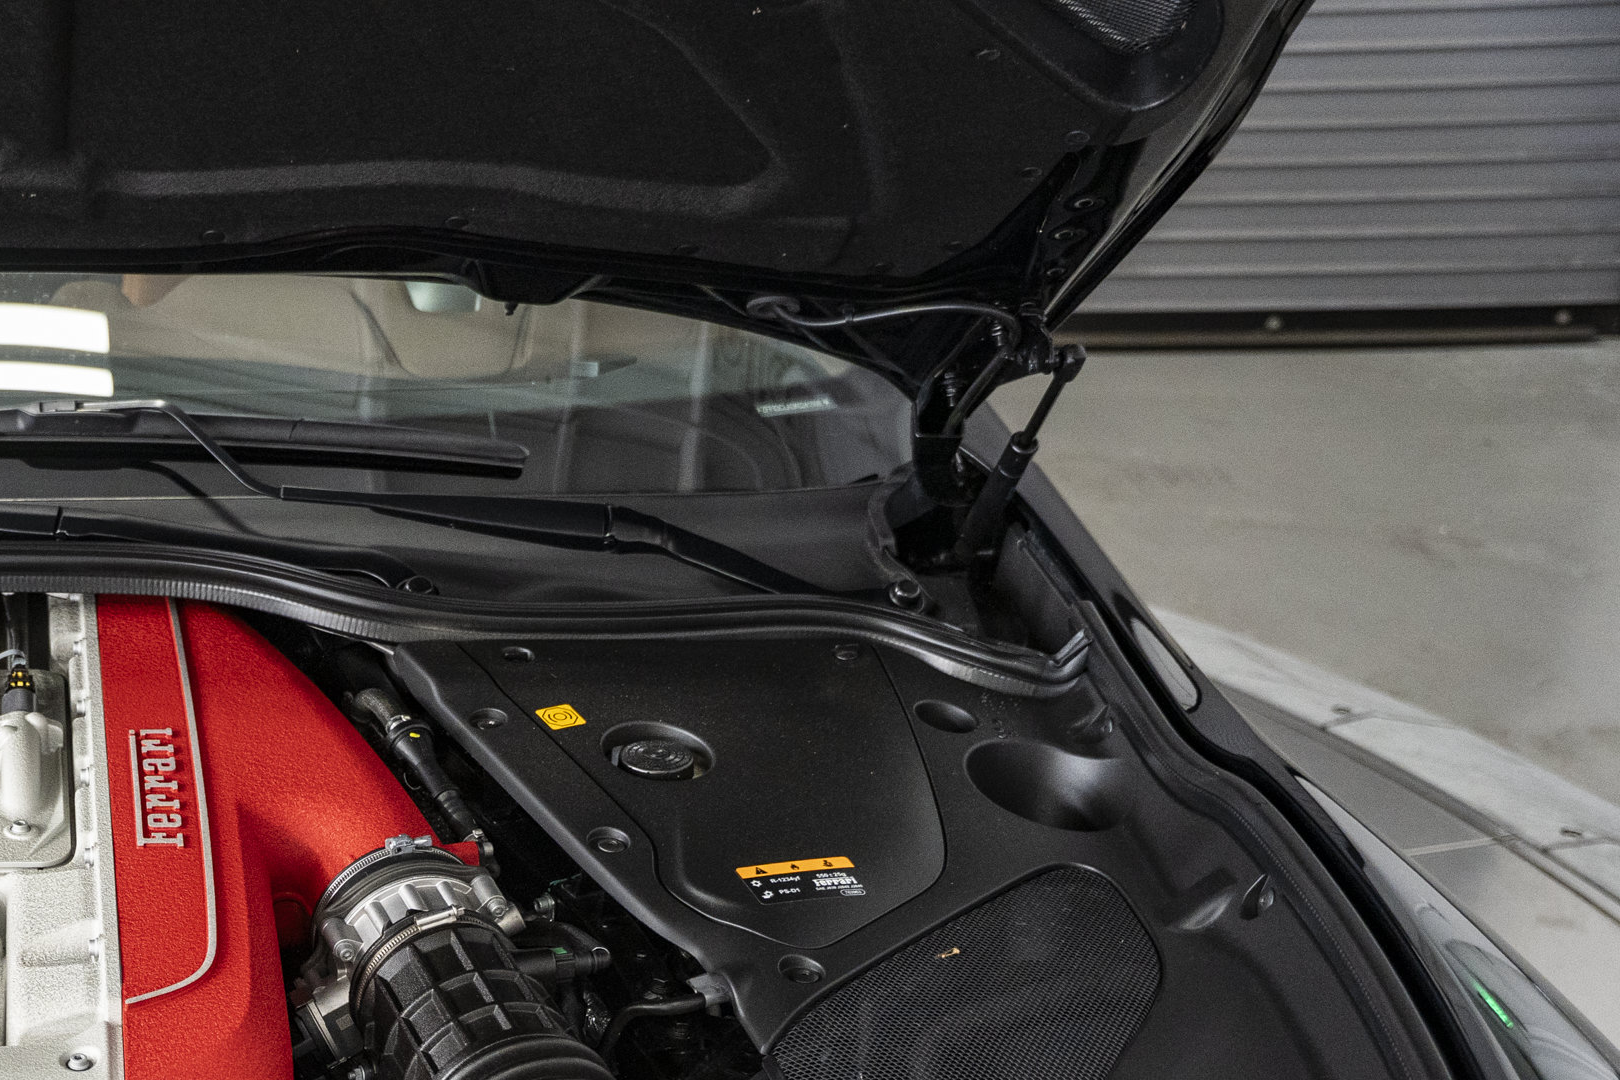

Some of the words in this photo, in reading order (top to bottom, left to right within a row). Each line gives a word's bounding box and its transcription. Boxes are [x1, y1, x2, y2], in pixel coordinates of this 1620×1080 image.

[129, 728, 184, 847] Ferrari
[770, 875, 800, 884] R-1234yf
[812, 876, 858, 887] Ferrari
